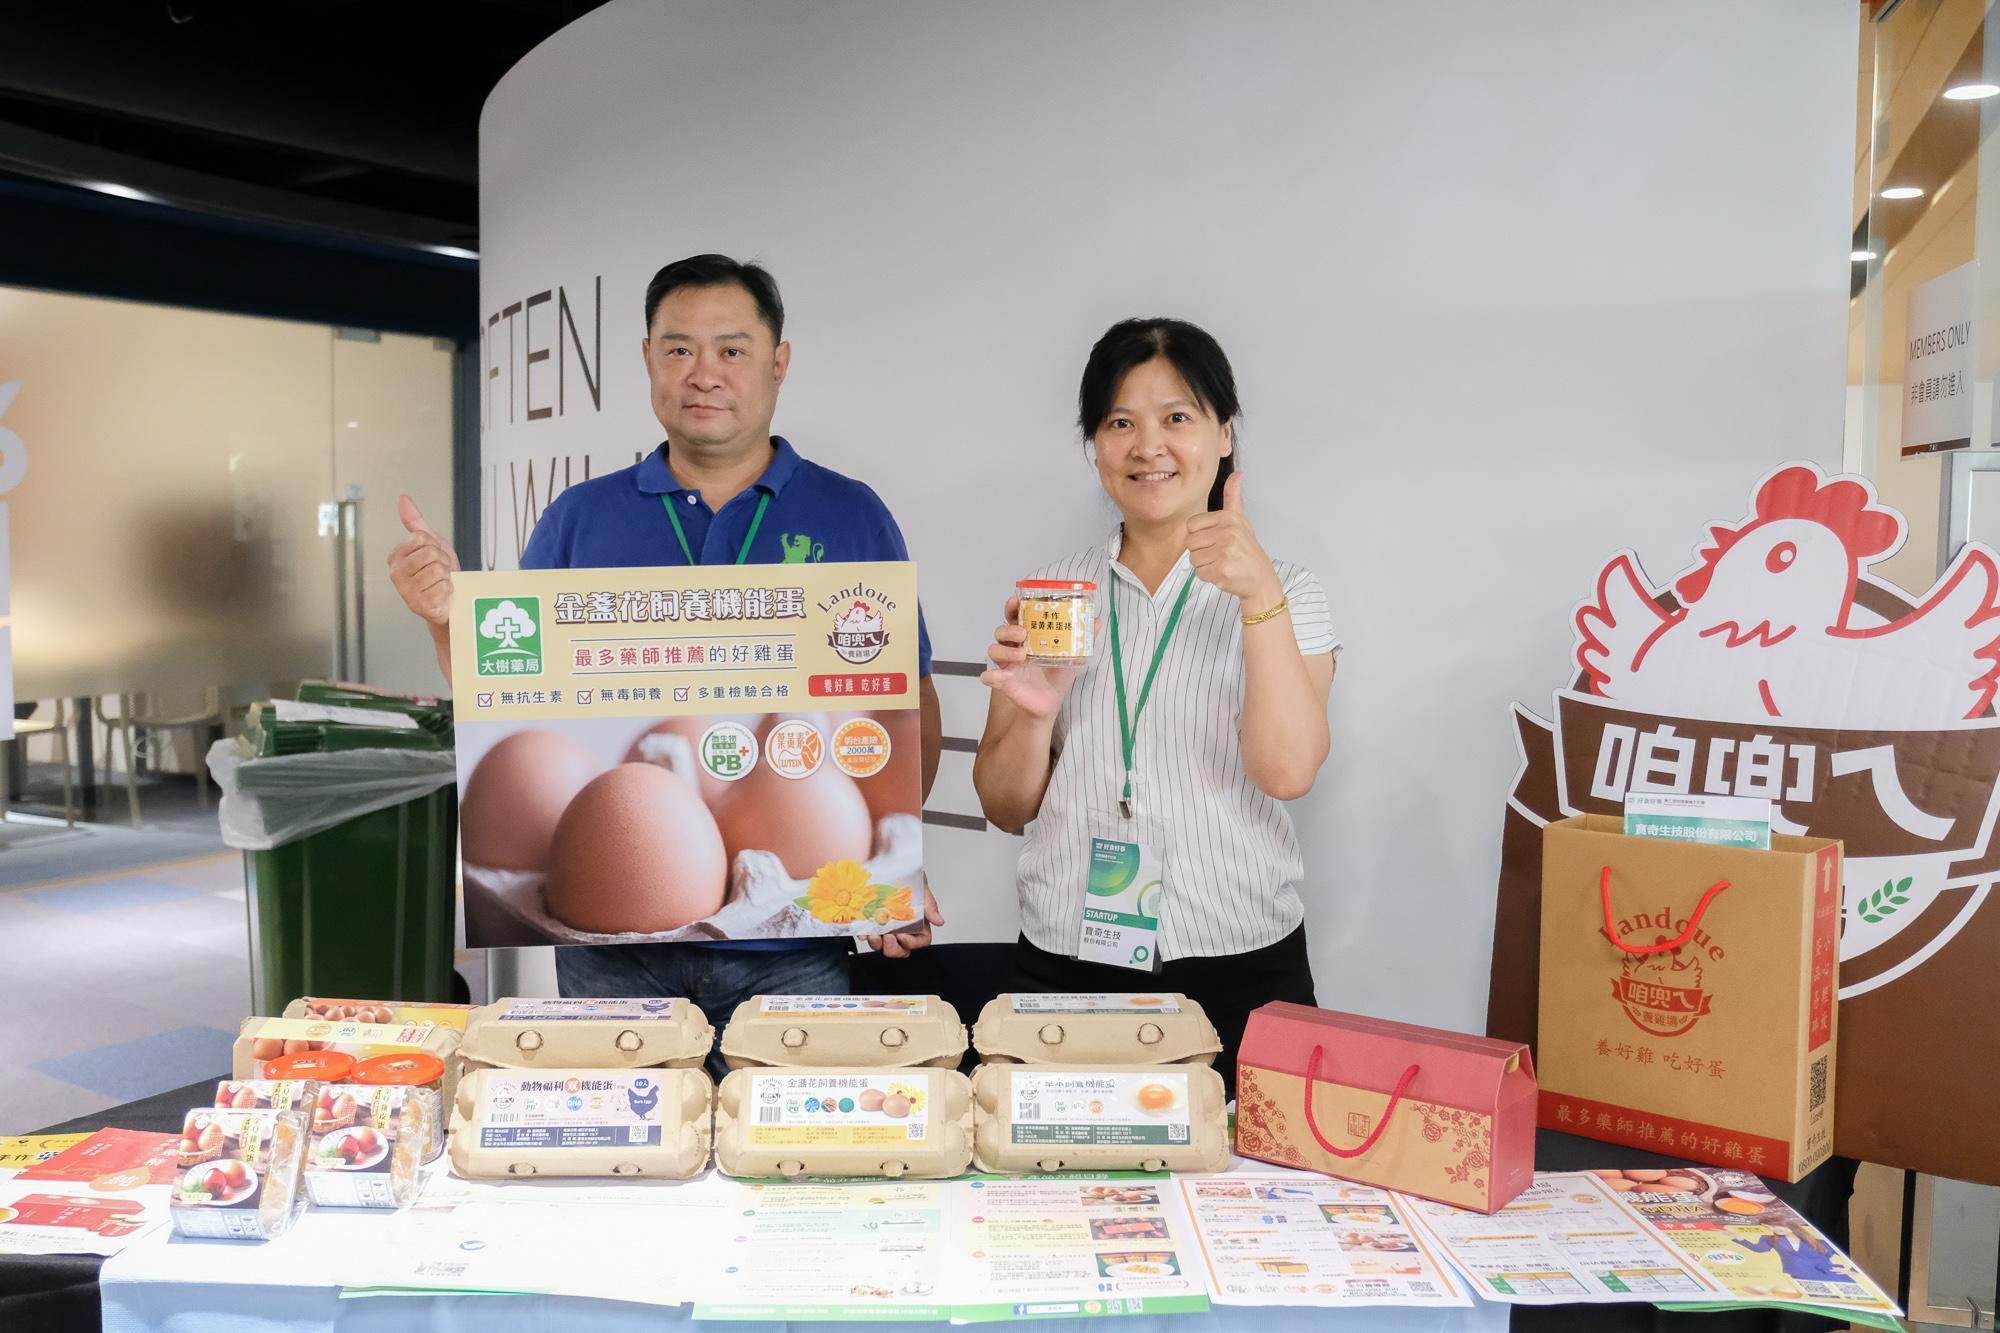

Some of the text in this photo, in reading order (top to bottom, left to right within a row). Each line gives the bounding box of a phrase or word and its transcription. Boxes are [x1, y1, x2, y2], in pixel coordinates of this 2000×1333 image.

[1909, 320, 1972, 360] MEMBERS ONLY
[481, 275, 601, 432] FTEN
[1911, 370, 1964, 404] 非會員請勿進入
[555, 587, 806, 625] 金盞花飼養機能蛋
[817, 582, 897, 613] Landoue
[575, 643, 795, 668] 最多藥師推薦的好雞蛋
[481, 659, 540, 674] 大樹藥局
[501, 684, 790, 705] 無抗生素 無毒飼養 多重檢驗合格
[861, 677, 891, 692] 吃好蛋
[847, 746, 876, 755] 2000萬
[712, 755, 742, 771] PB
[781, 759, 802, 768] LUTEIN
[1635, 823, 1757, 843] 寶奇生技股份有限公司
[1085, 909, 1119, 922] STARTUP
[1084, 937, 1119, 949] 股份有限公司
[1085, 926, 1121, 941] 寶奇生技
[1643, 1011, 1678, 1028] 養雞場
[1596, 1039, 1726, 1079] 養好雞 吃好蛋
[1556, 1104, 1767, 1166] 最多藥師推薦的好雞蛋
